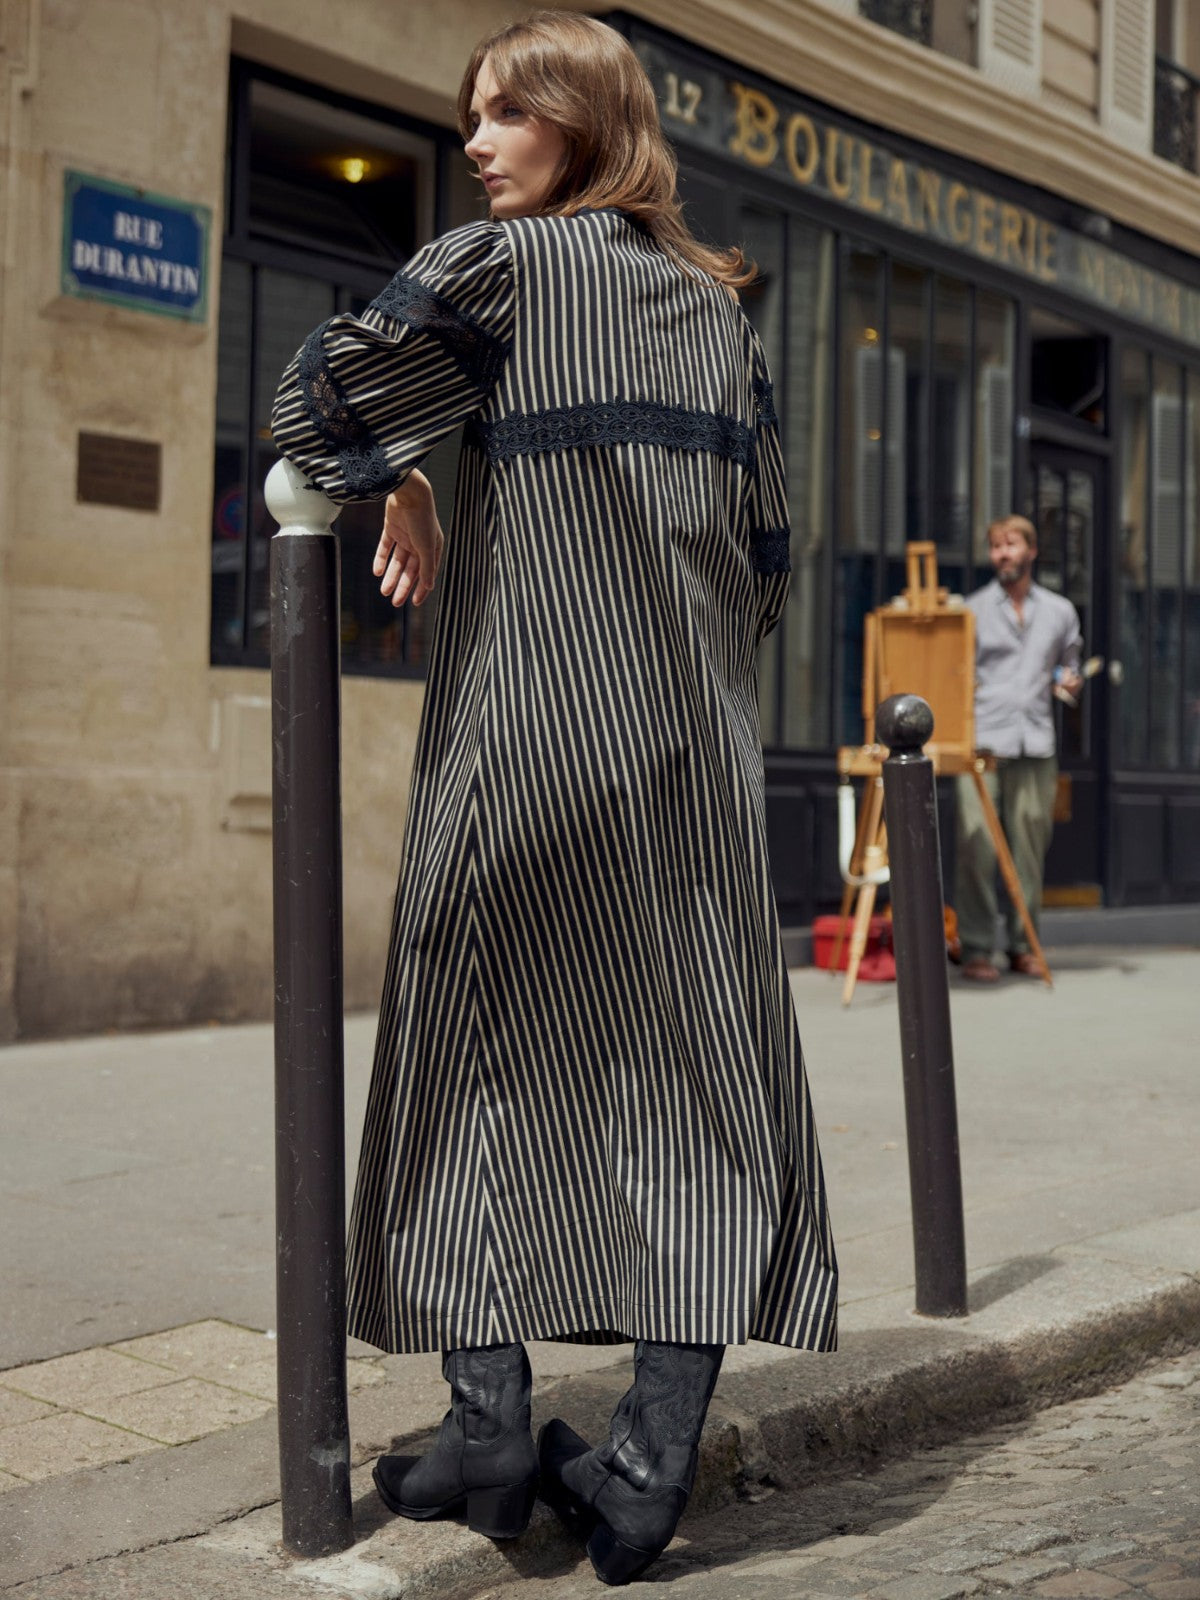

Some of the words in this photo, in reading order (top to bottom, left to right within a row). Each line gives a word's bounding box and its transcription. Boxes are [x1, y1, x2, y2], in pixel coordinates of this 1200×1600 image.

[664, 72, 702, 125] 17
[729, 81, 1058, 283] BOULANGERIE
[114, 211, 163, 250] RUE
[73, 239, 200, 296] DURANTIN
